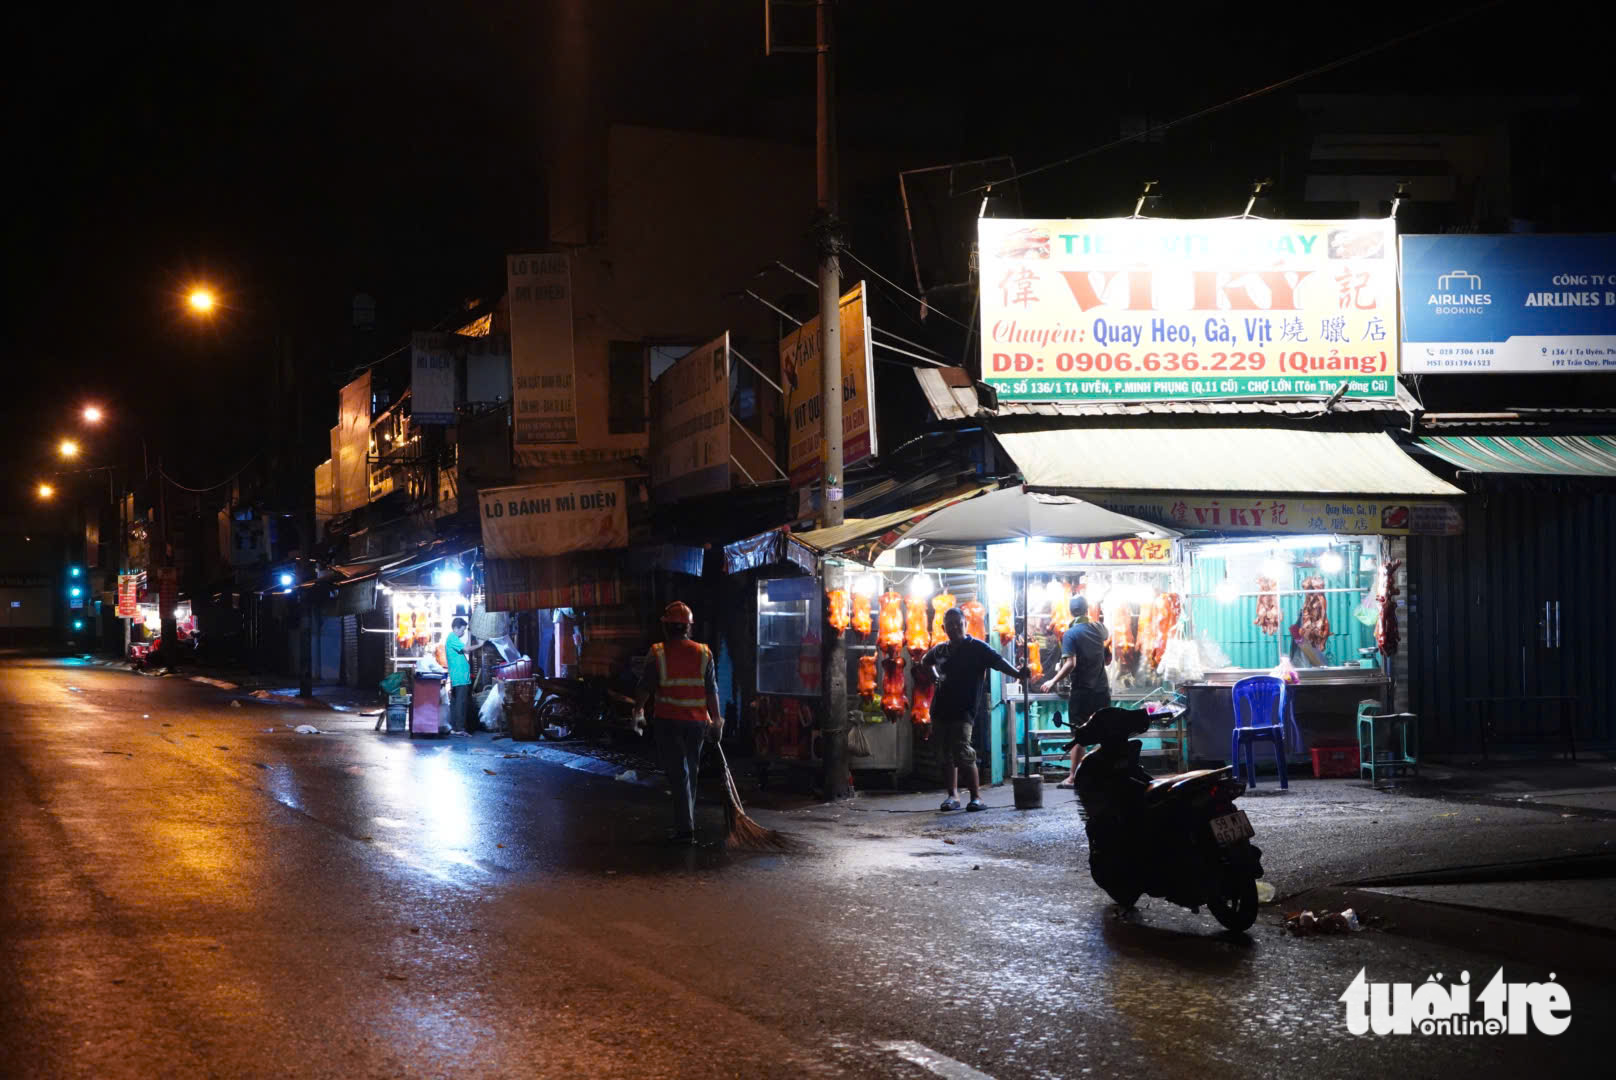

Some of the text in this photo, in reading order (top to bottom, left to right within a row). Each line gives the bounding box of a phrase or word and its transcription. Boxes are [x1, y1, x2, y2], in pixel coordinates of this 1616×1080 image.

[1335, 267, 1378, 310] 記
[1552, 273, 1588, 286] CÔNG
[1591, 275, 1605, 286] TY
[1428, 294, 1492, 305] AIRLINES
[1524, 292, 1600, 306] AIRLINES
[1435, 307, 1483, 315] BOOKING
[1093, 317, 1143, 347] Quay
[1152, 318, 1197, 347] Heo,
[1204, 317, 1237, 347] Gà,
[1244, 317, 1272, 347] Vịt
[992, 349, 1388, 374] DĐ: 0906.636.229 (Quảng)
[1013, 379, 1028, 393] SỐ
[1031, 382, 1061, 394] 136/1
[1066, 382, 1078, 395] TẠ
[1115, 381, 1150, 393] P.MINH
[1154, 381, 1188, 395] PHỤNG
[1248, 379, 1269, 394] CHỢ
[1271, 379, 1291, 393] LỚN
[485, 490, 617, 518] LÒ BÁNH MÌ ĐIỆN
[1229, 501, 1265, 526] KÝ
[1270, 501, 1288, 526] 記
